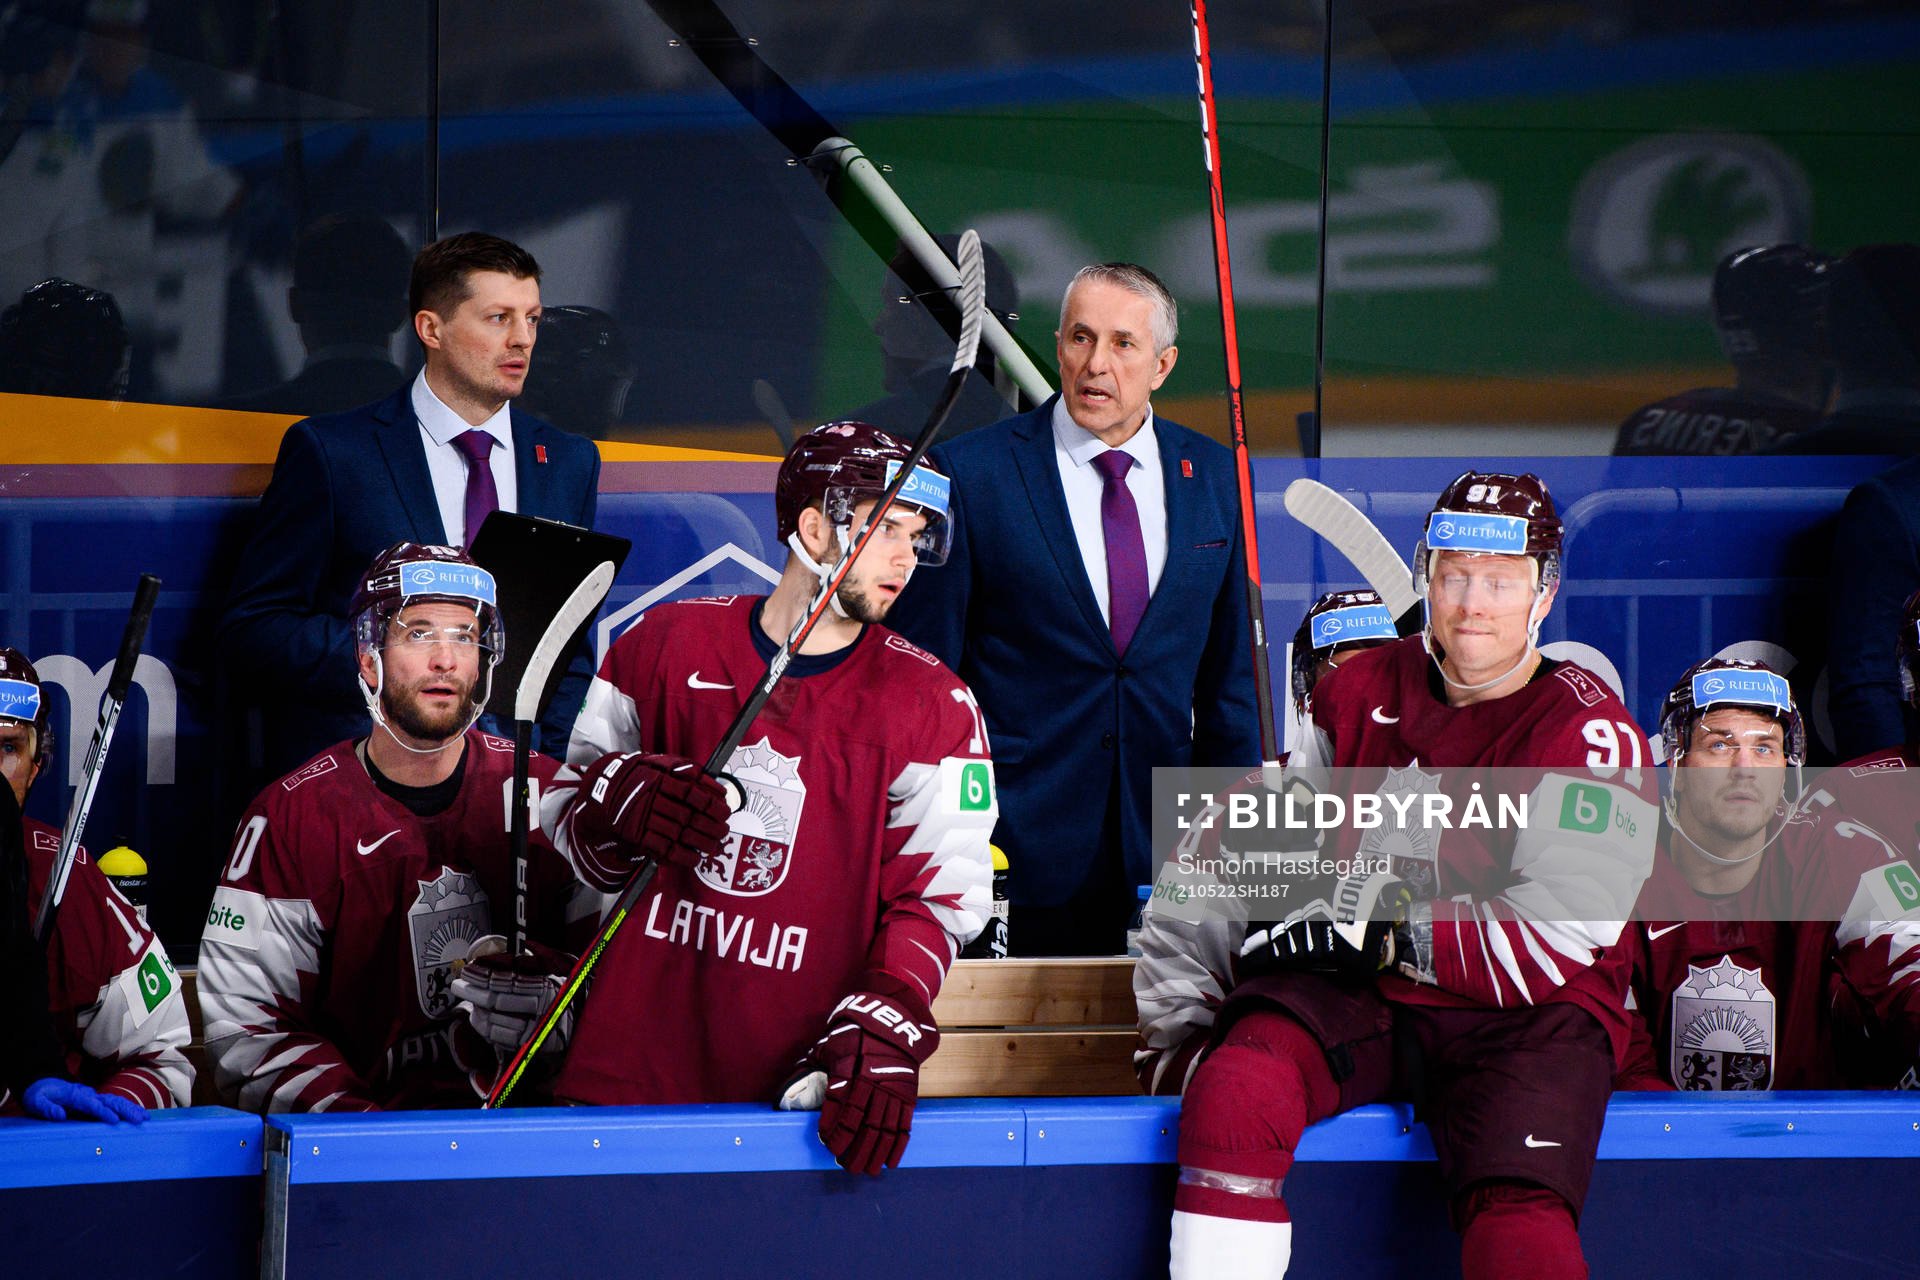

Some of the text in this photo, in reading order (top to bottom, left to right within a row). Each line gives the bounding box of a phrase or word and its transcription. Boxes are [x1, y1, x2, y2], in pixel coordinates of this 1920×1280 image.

[1466, 484, 1501, 504] 91
[1458, 526, 1517, 541] RIETUMU
[1346, 614, 1394, 628] RIETUM
[764, 654, 792, 694] BAUER
[1729, 680, 1783, 696] RIETUMU
[1581, 718, 1644, 791] 91
[1615, 804, 1637, 838] bite
[208, 902, 245, 931] bite
[644, 891, 809, 973] LATVIJA
